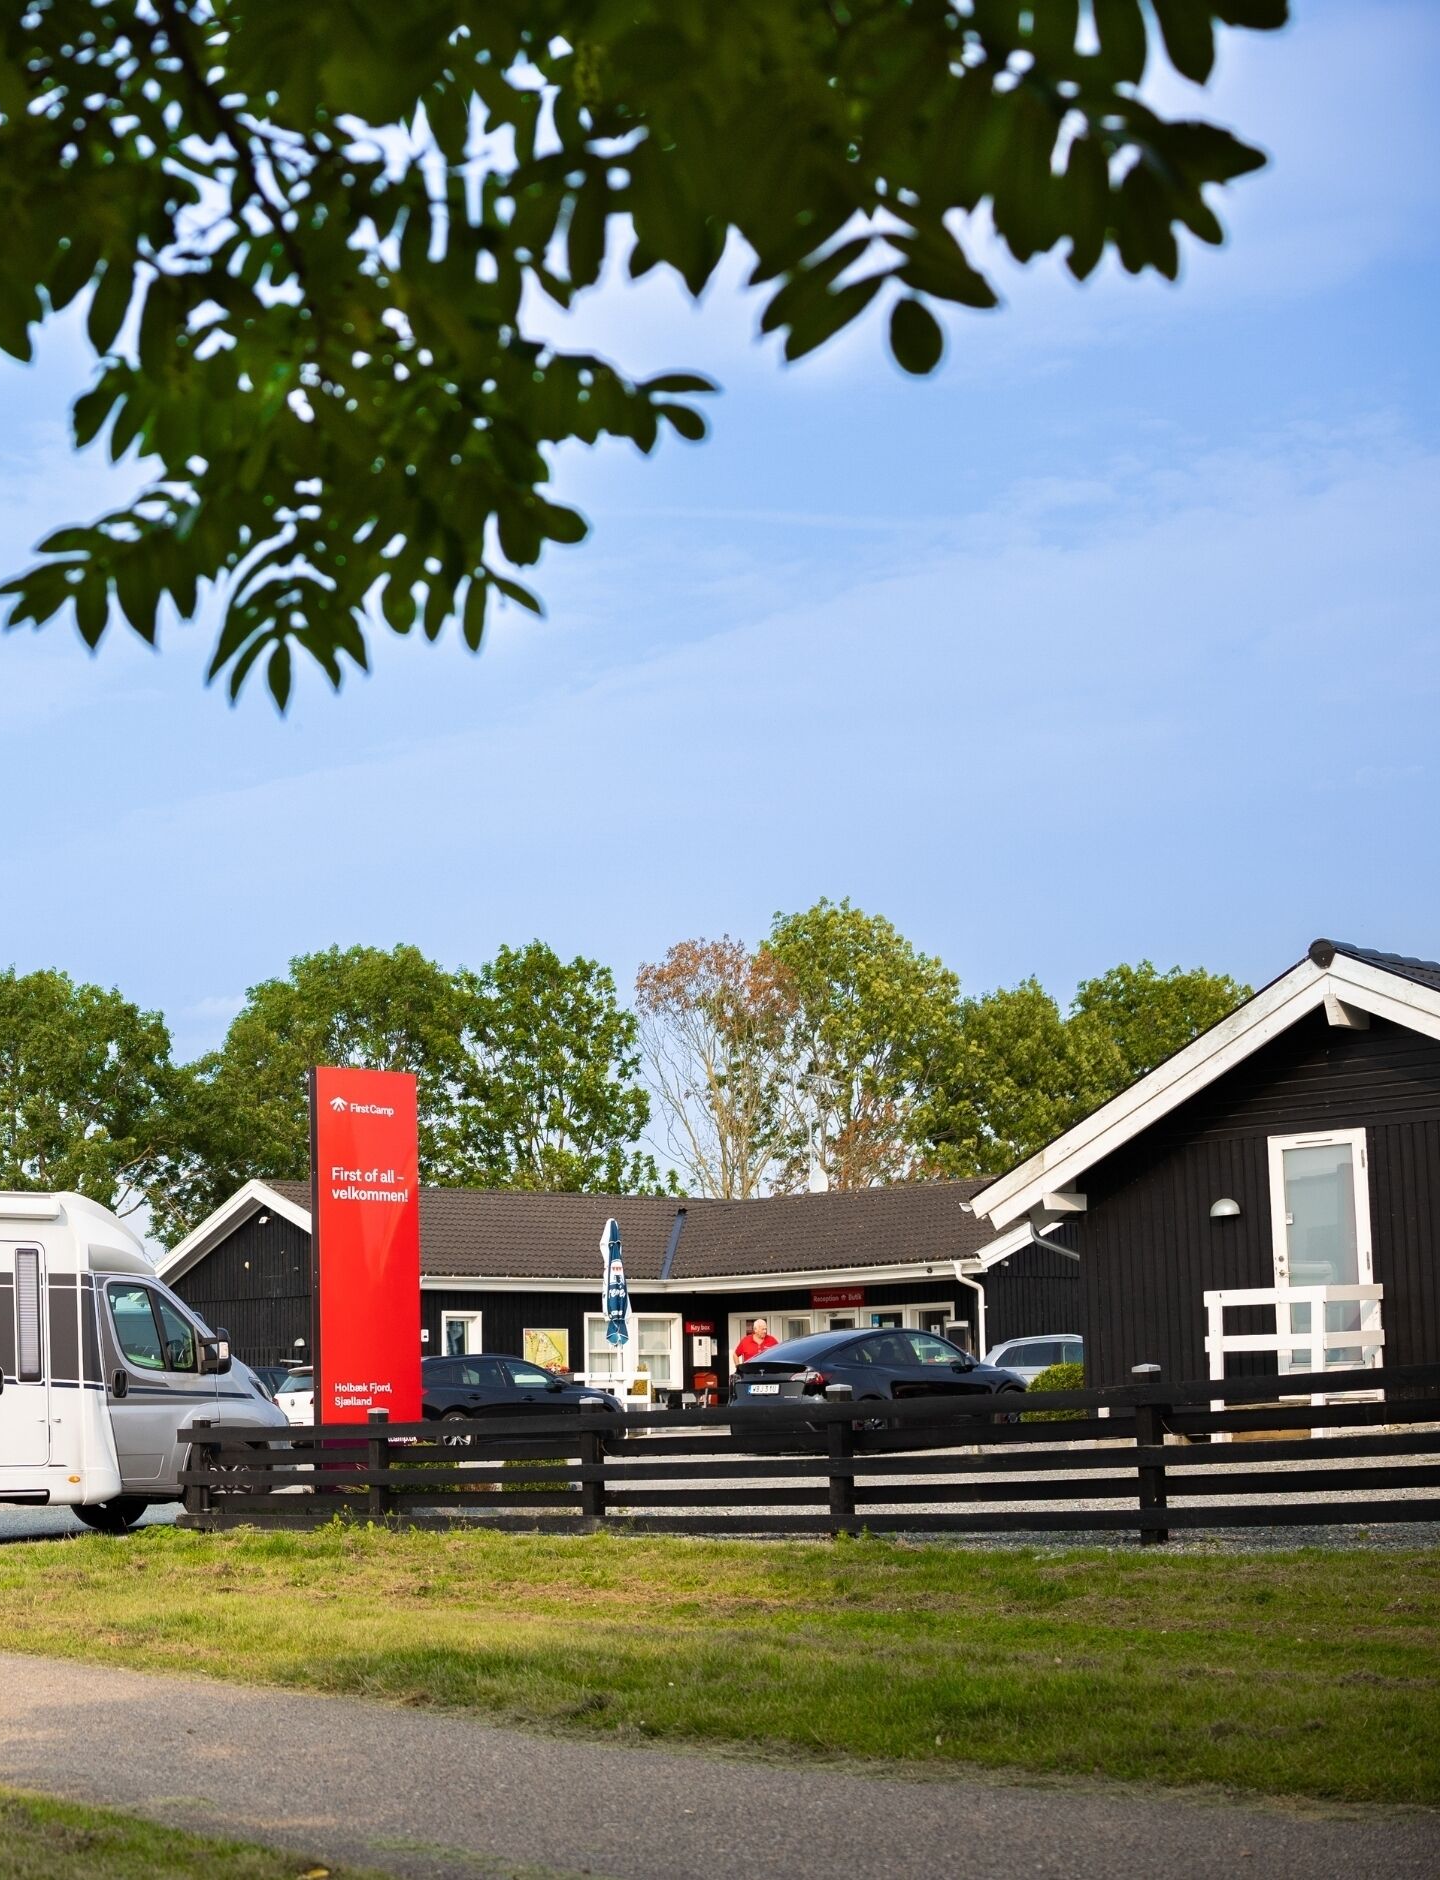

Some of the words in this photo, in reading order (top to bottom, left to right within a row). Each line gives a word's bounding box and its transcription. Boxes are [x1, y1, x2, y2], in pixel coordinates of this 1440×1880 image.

[331, 1167, 362, 1181] First
[364, 1168, 378, 1182] of
[380, 1170, 394, 1183] all
[331, 1186, 408, 1202] velkommen!
[813, 1294, 839, 1303] Reception
[335, 1383, 368, 1392] Holbæk
[369, 1383, 392, 1394] Fjord,
[335, 1396, 372, 1408] Sjælland
